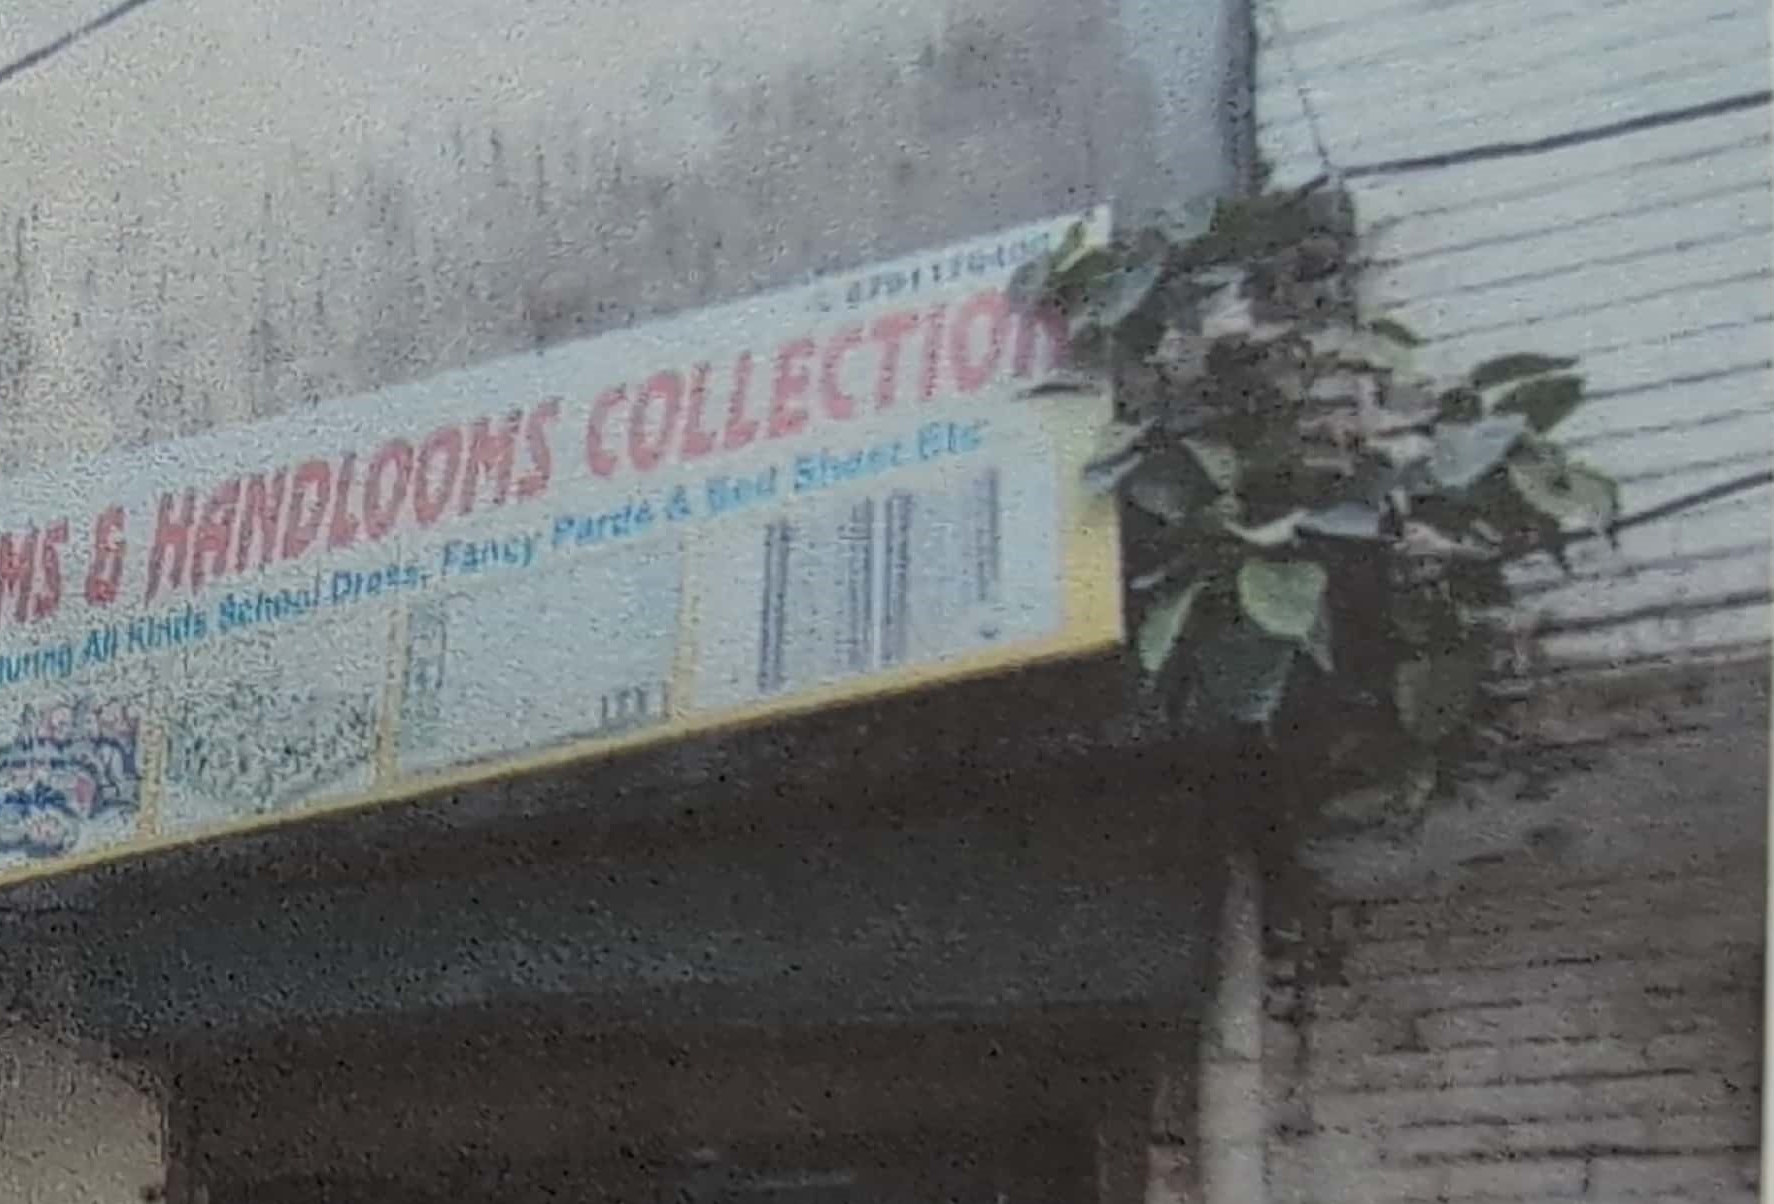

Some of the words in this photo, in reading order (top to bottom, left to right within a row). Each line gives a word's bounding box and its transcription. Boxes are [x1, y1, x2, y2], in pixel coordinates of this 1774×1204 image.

[84, 502, 125, 608] &
[144, 396, 563, 600] HANDLOOMS
[585, 288, 1069, 478] COLLECTION
[440, 530, 538, 576] Fancy
[664, 484, 692, 522] &
